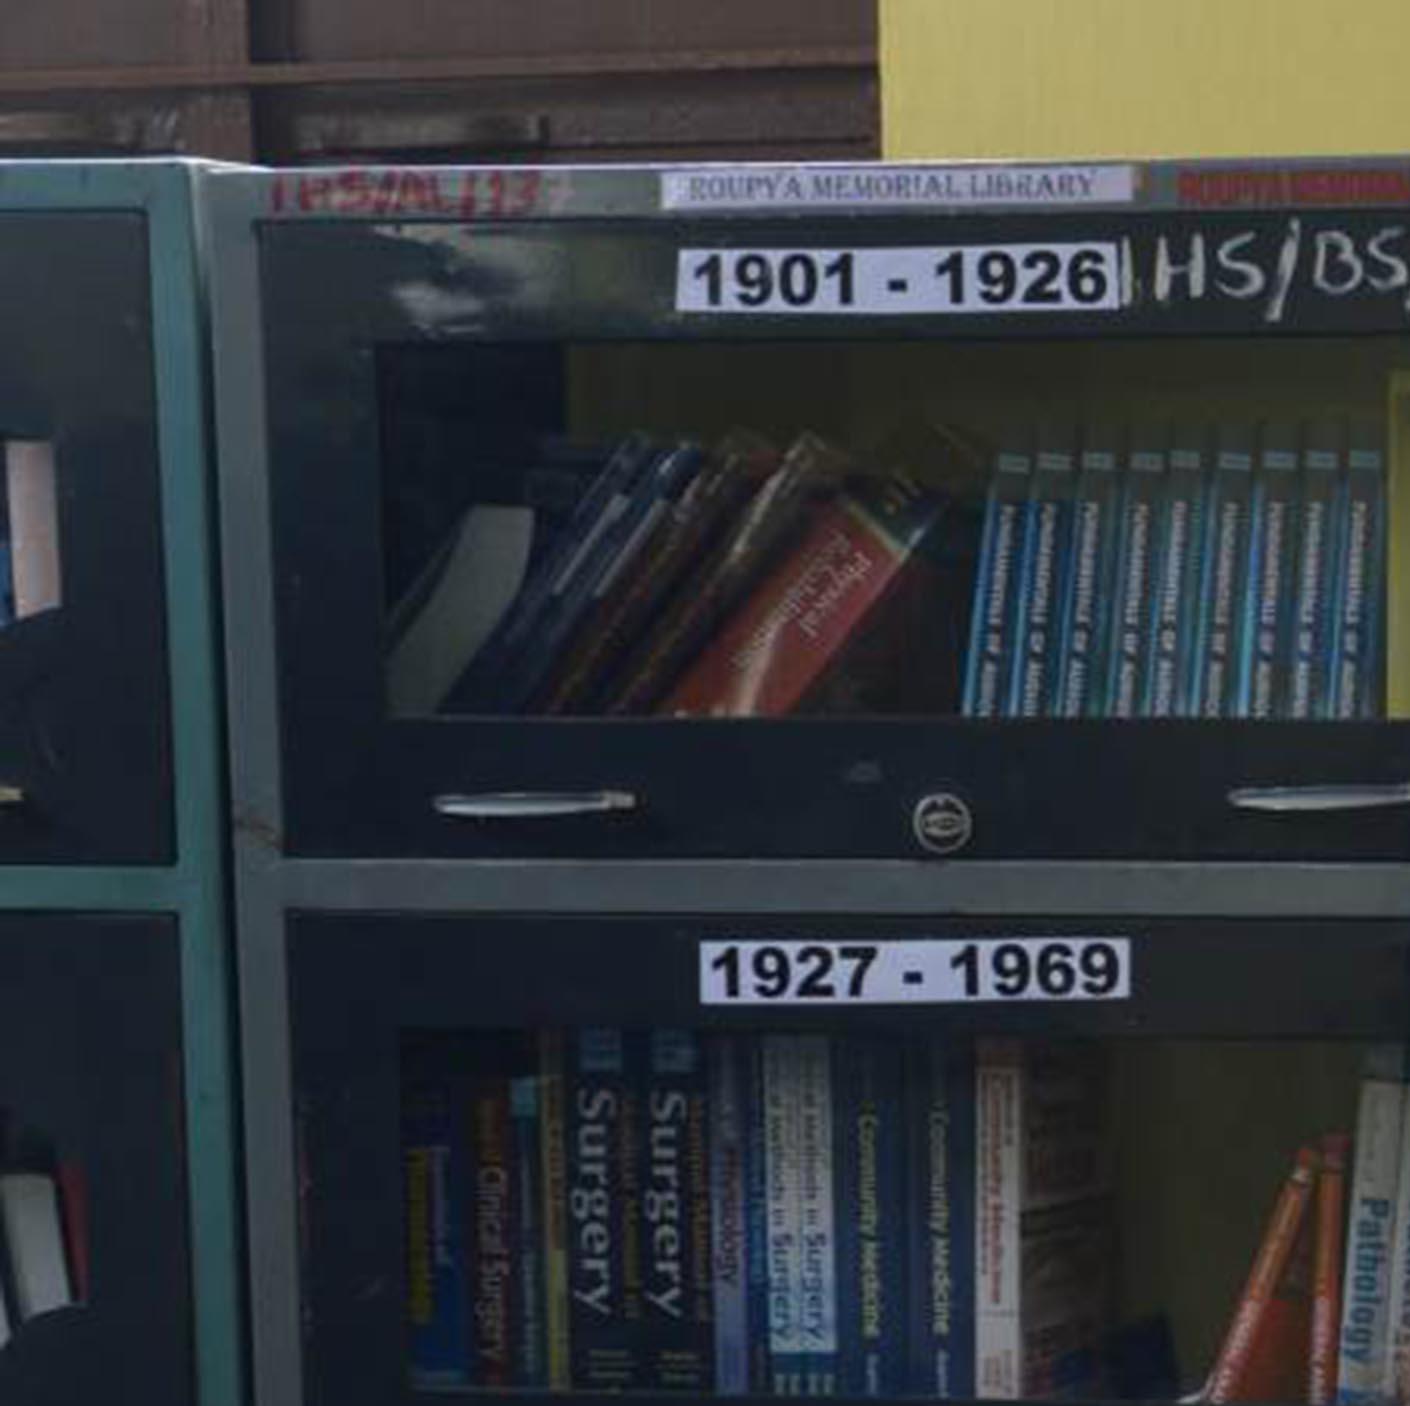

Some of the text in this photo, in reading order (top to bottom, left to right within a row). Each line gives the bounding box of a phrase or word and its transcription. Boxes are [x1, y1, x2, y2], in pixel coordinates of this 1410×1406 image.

[690, 171, 1097, 200] ROUPYA MEMORIAL LIBRARY
[694, 252, 854, 307] 1901
[935, 251, 1108, 305] 1926
[711, 946, 878, 998] 1927
[950, 943, 1120, 996] 1969
[572, 1088, 616, 1316] Surgery
[644, 1088, 687, 1318] Surgery
[769, 1232, 793, 1340] Surgery
[803, 1232, 826, 1340] Surgery
[931, 1236, 954, 1336] Medicine
[1343, 1198, 1390, 1363] Pathology
